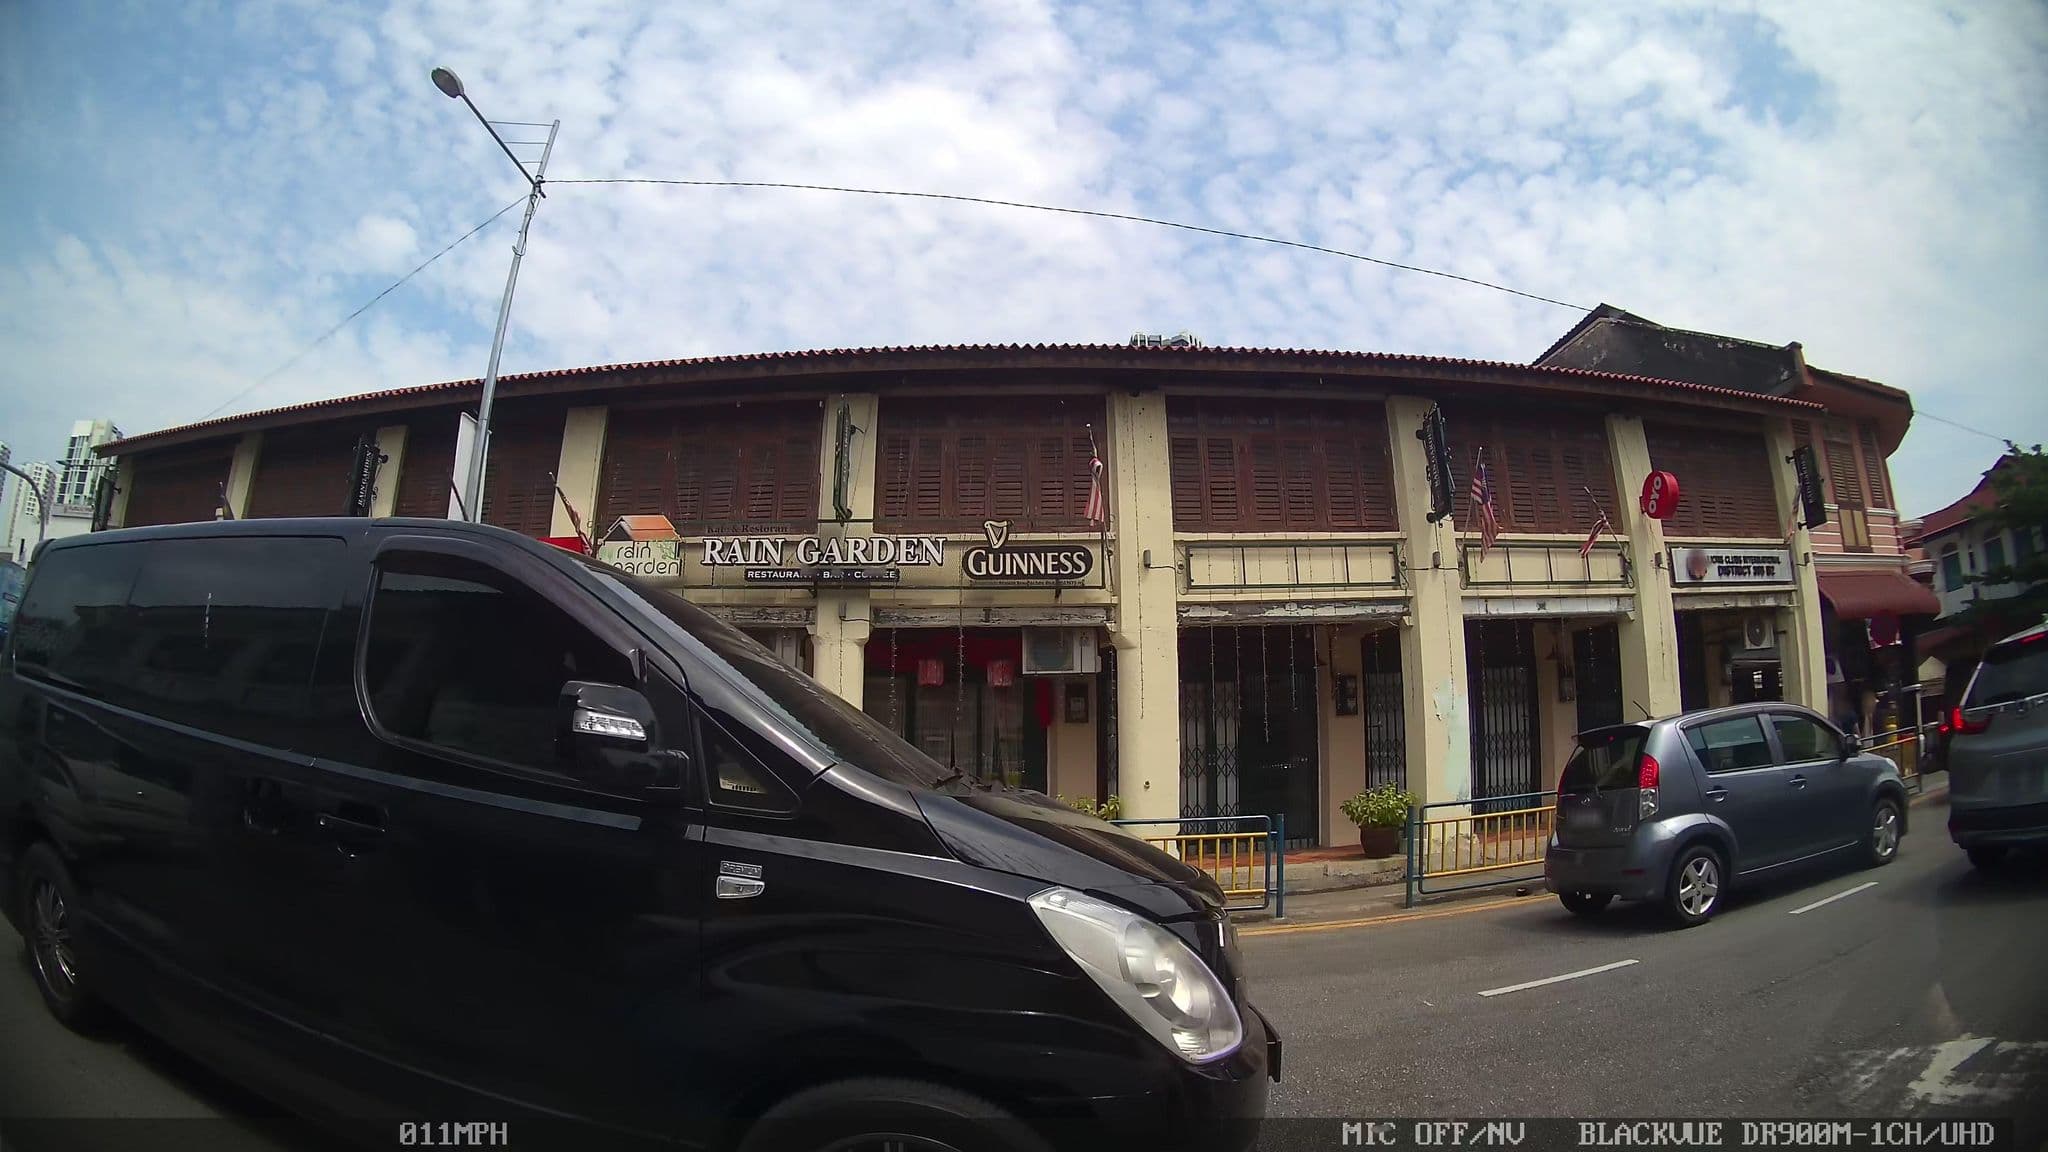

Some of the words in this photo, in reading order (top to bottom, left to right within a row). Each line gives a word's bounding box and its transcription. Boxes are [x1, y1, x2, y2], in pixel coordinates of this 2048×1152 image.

[358, 484, 366, 506] RAIN
[741, 523, 789, 533] Restoran
[617, 541, 652, 558] rain
[701, 537, 785, 565] RAIN
[796, 537, 947, 566] GARDEN
[967, 549, 1087, 576] GUINNESS
